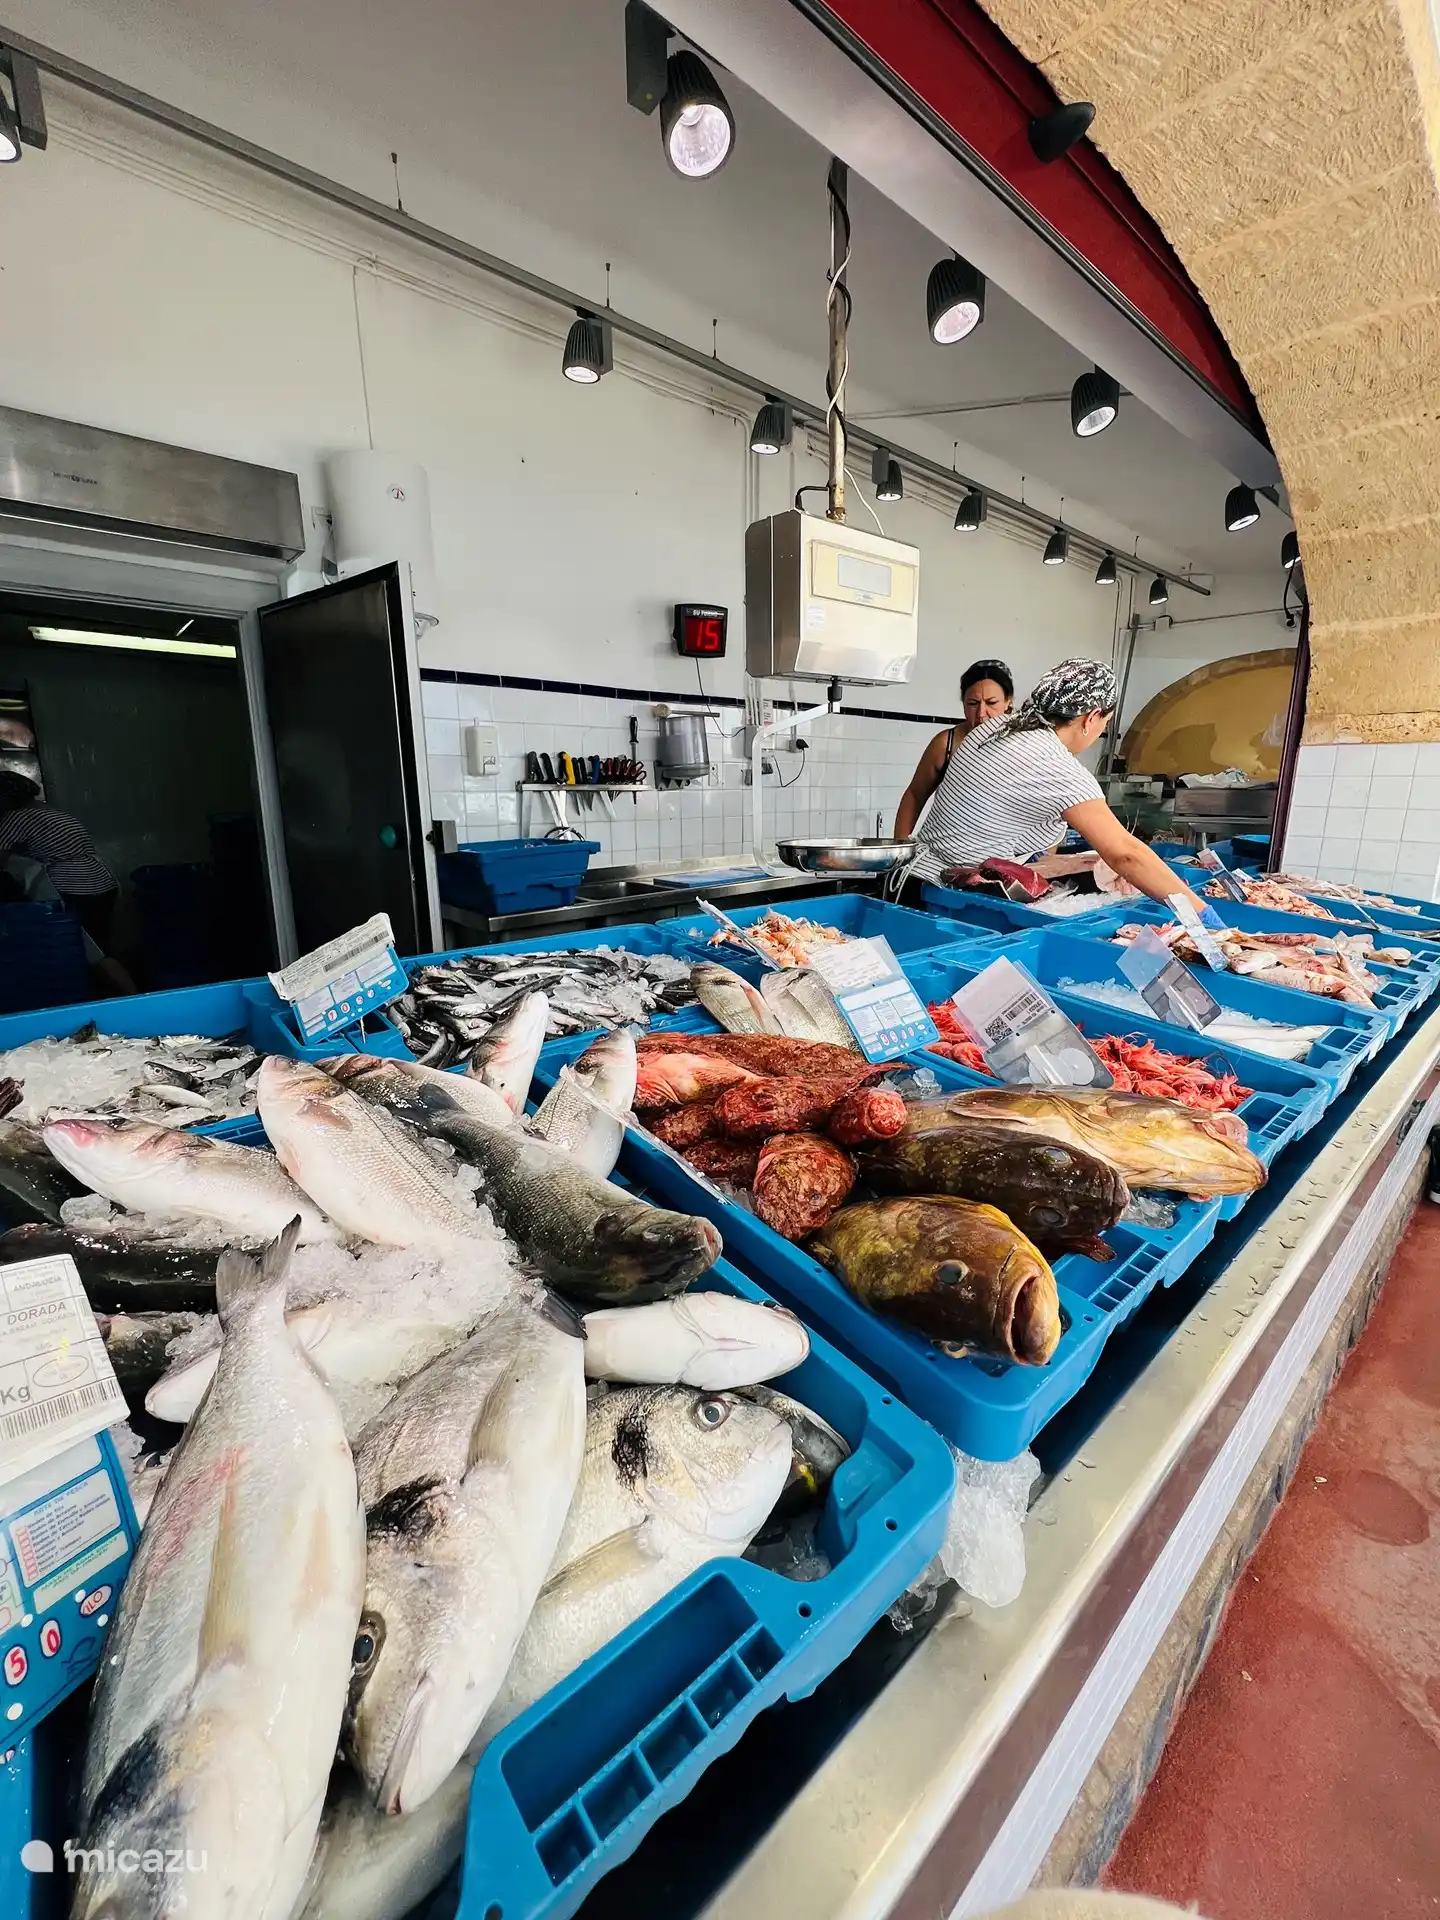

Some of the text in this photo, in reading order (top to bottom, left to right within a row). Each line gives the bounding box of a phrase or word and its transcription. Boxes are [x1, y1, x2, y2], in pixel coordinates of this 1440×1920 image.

[697, 620, 718, 650] 15
[7, 1302, 67, 1325] DORADA
[0, 1384, 31, 1403] Kg
[9, 1649, 26, 1679] 5
[47, 1629, 60, 1654] 0
